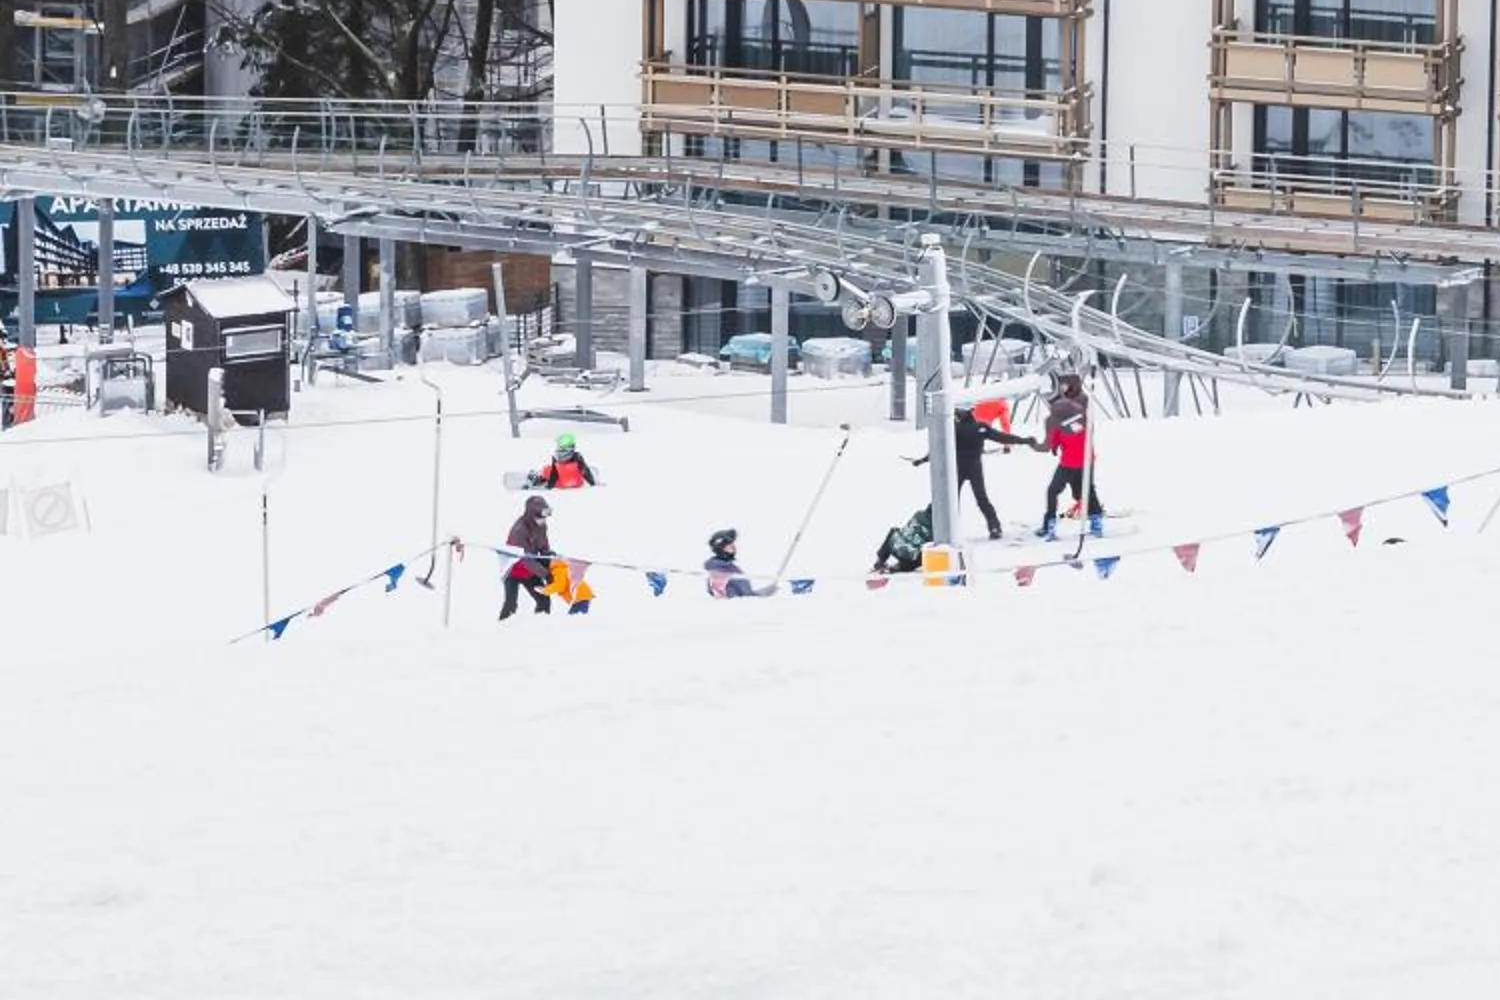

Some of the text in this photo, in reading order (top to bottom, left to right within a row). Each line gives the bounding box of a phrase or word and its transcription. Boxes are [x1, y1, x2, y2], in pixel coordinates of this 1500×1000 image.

[155, 213, 248, 232] NA SPRZEDAŻ
[228, 260, 251, 273] 345
